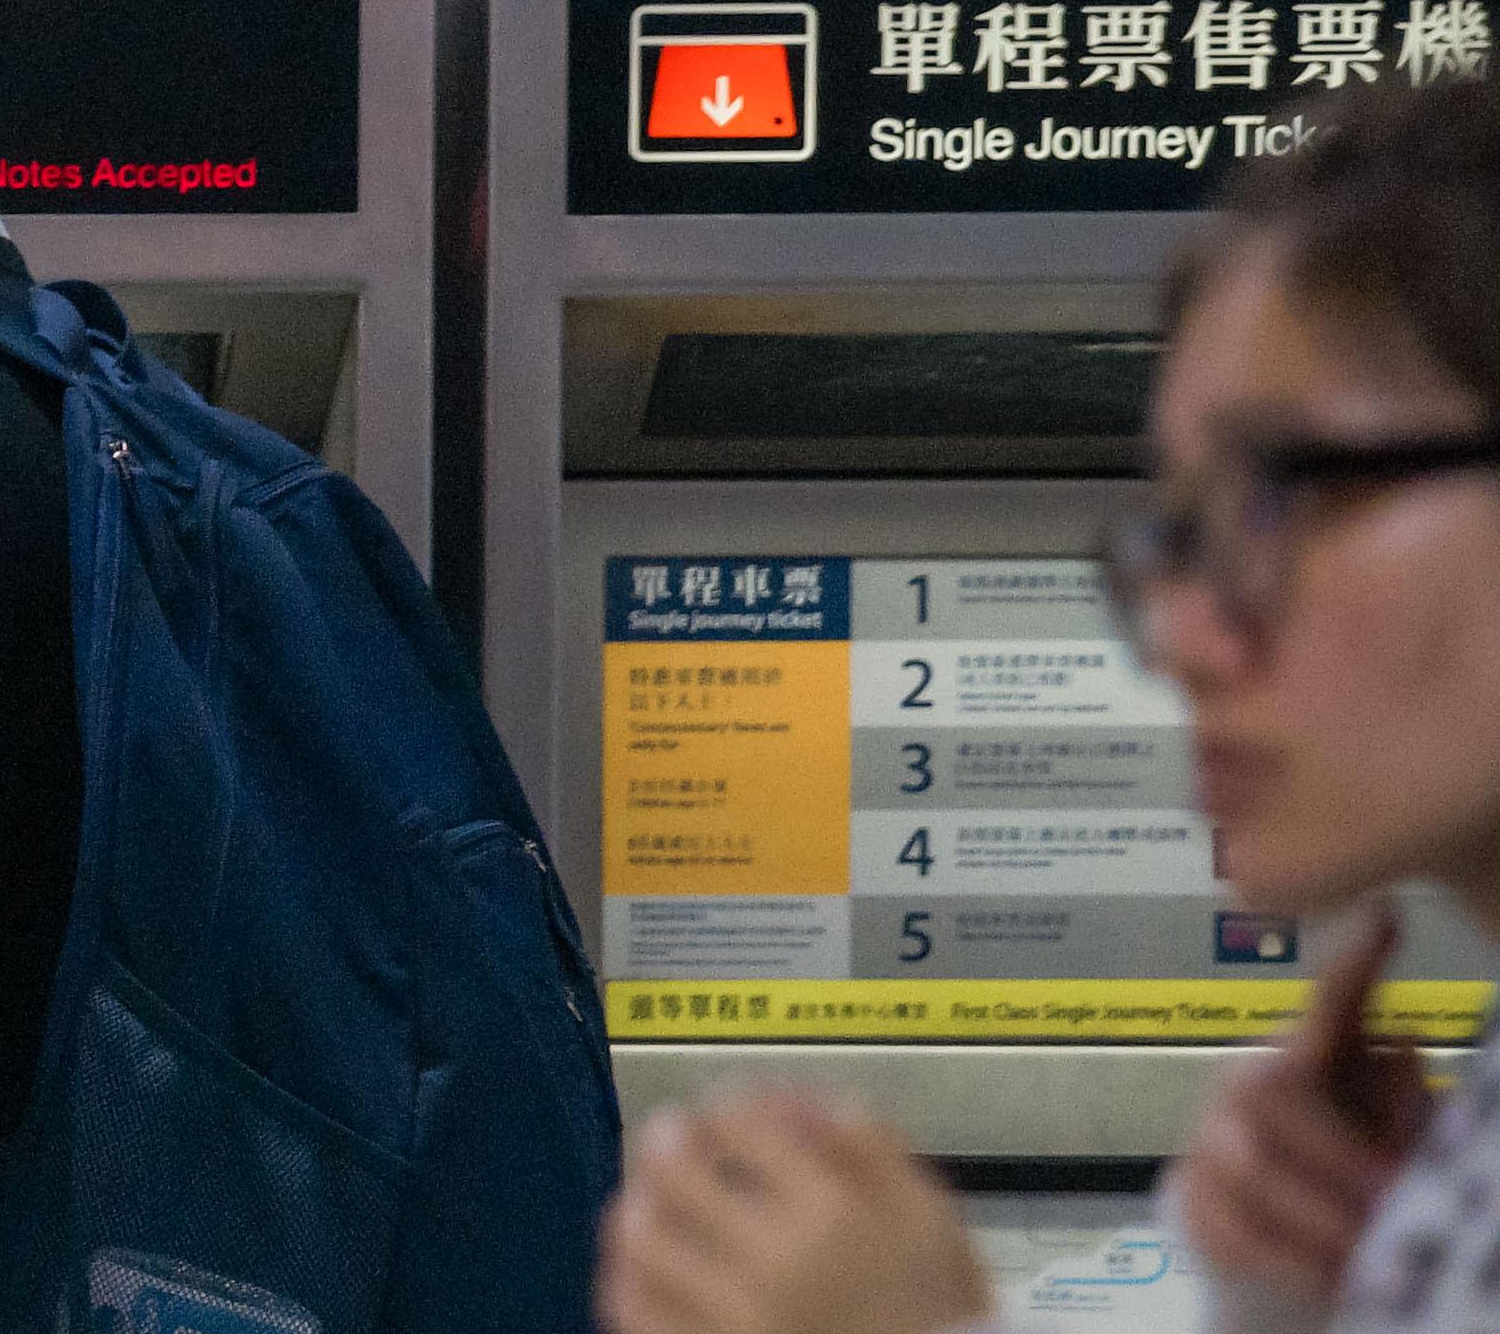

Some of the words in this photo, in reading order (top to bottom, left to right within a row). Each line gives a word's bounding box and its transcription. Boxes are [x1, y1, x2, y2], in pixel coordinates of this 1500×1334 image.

[869, 118, 1014, 170] Single
[1024, 118, 1216, 170] Journey
[92, 157, 257, 193] Accepted
[630, 565, 824, 606] 單程車票
[906, 574, 930, 623] 1
[628, 610, 688, 634] Single
[900, 658, 934, 708] 2
[900, 742, 934, 794] 3
[899, 827, 935, 876] 4
[901, 912, 932, 964] 5
